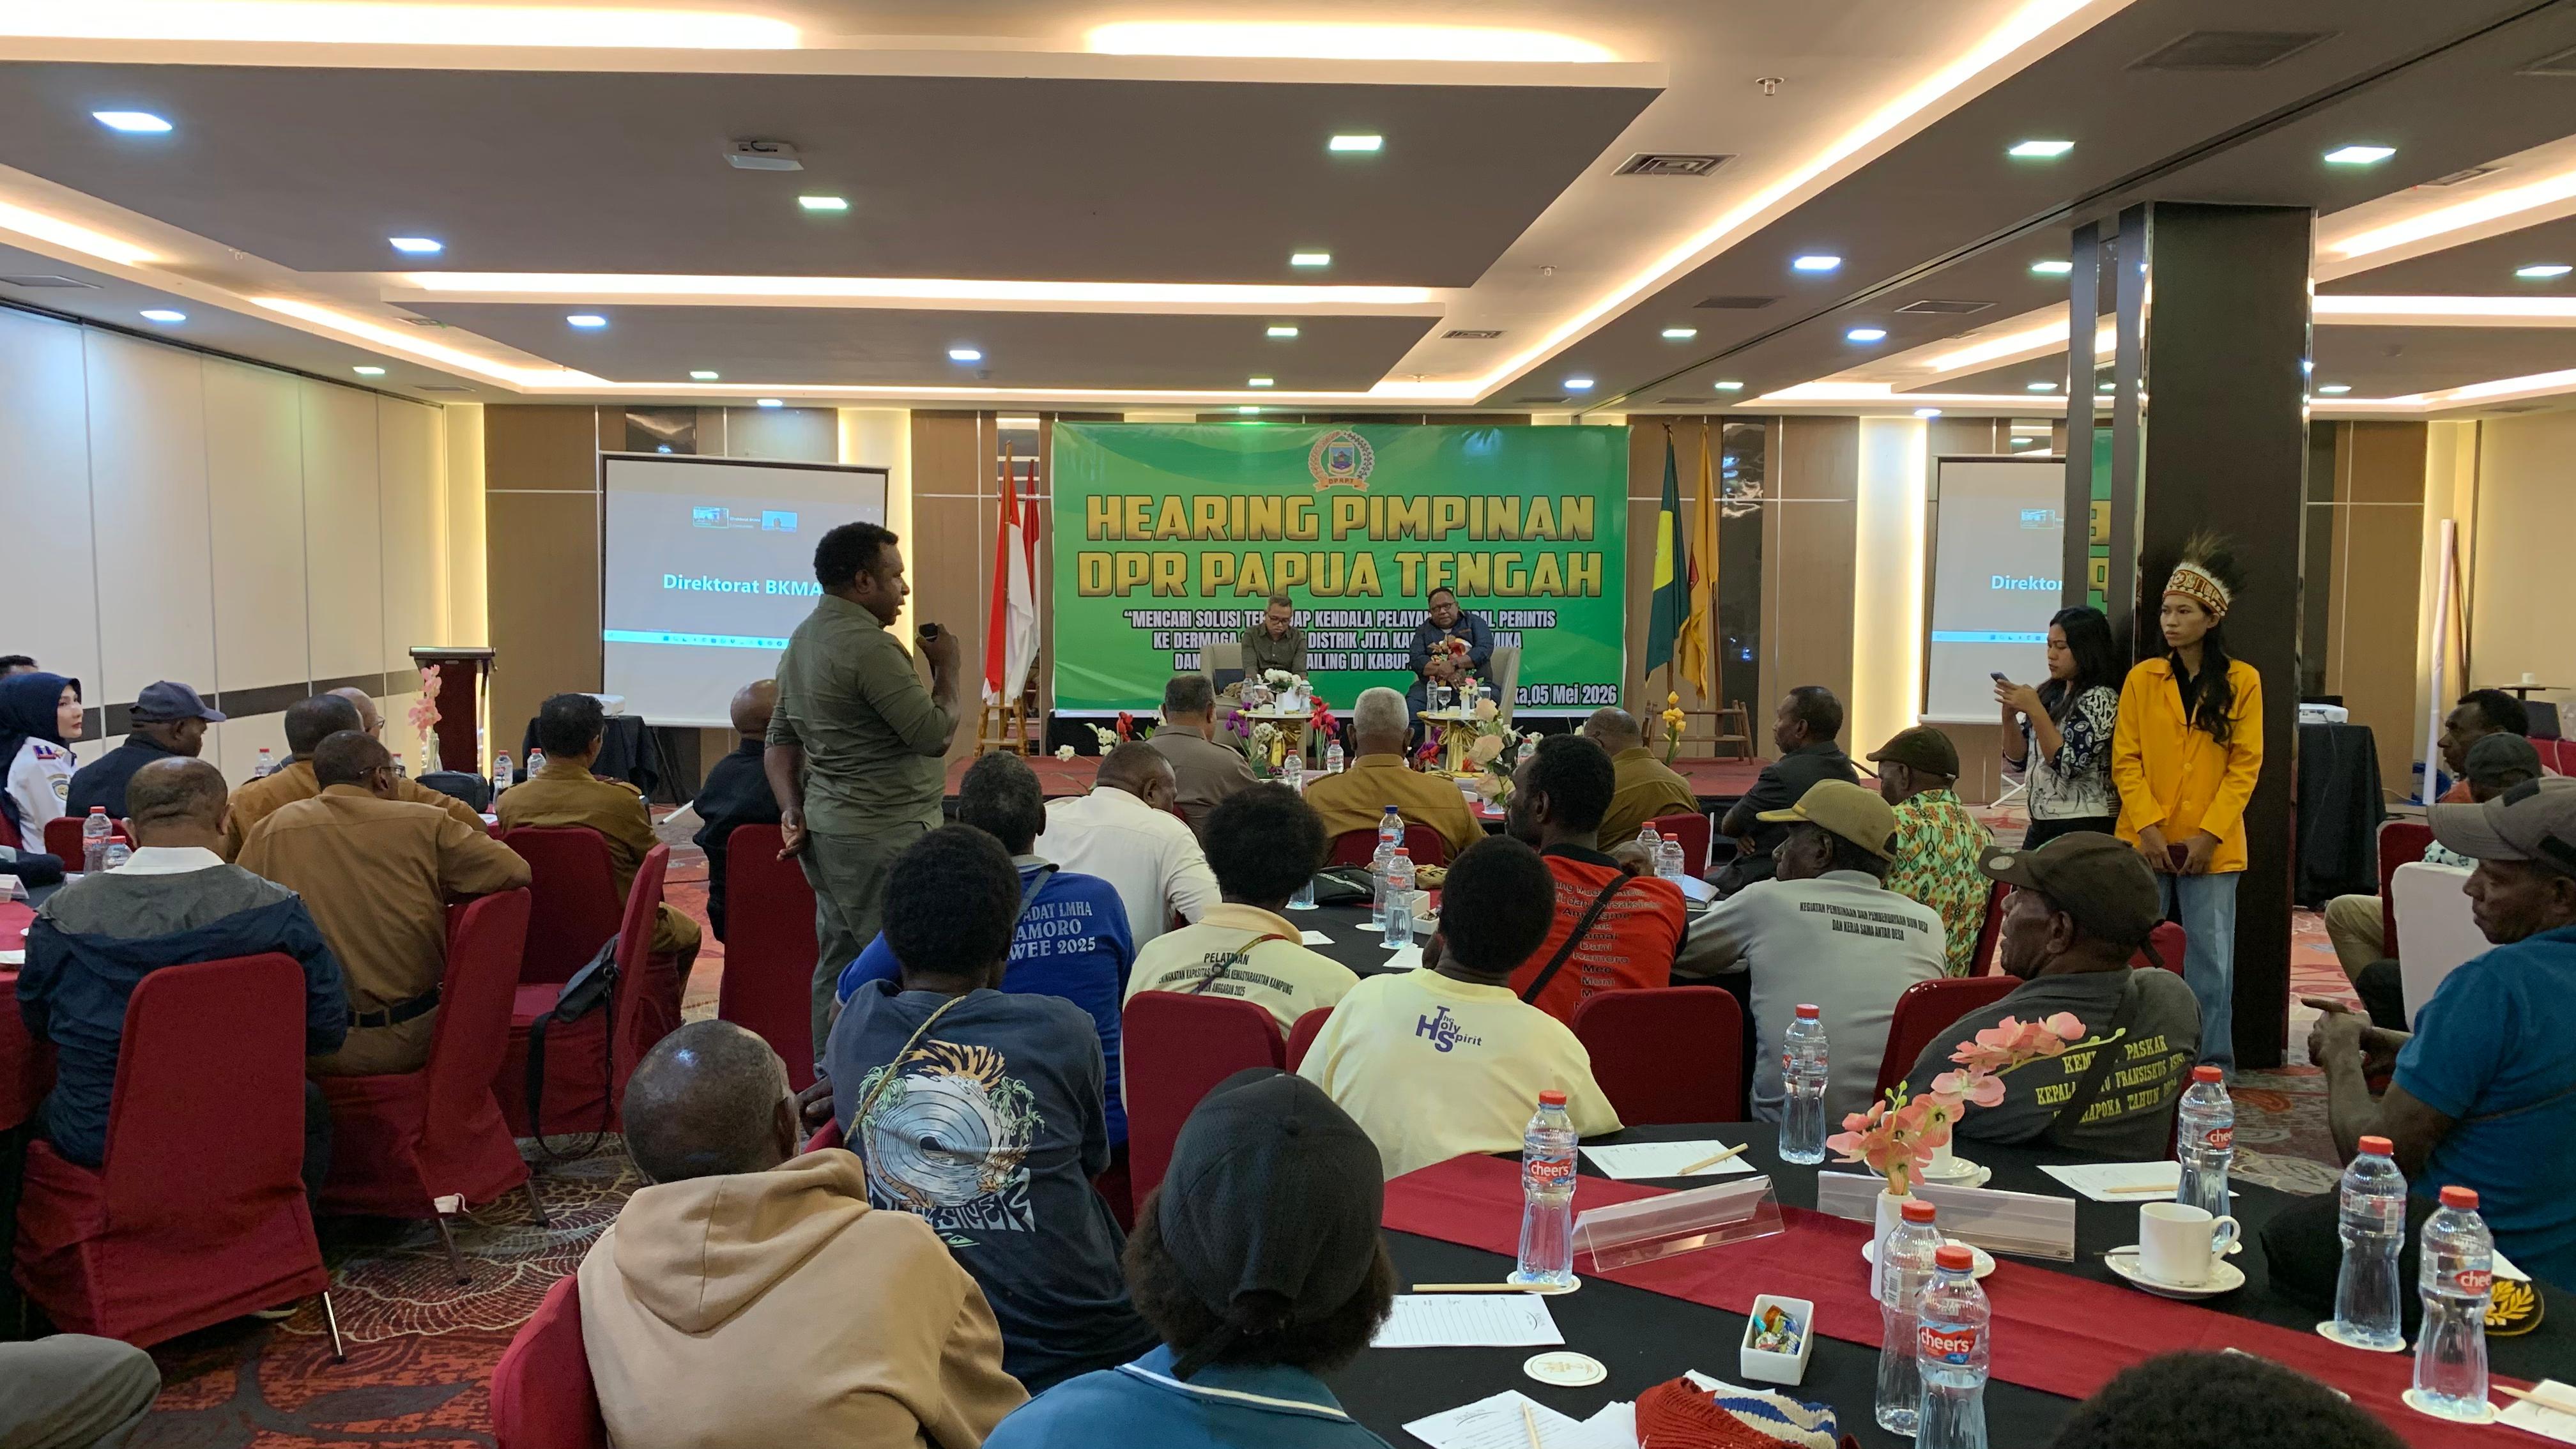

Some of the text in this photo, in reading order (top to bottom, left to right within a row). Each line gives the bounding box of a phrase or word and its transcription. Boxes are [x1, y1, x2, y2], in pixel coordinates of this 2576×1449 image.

[1086, 495, 1595, 541] HEARING PIMPINAN
[664, 574, 760, 594] Direktorat
[1078, 551, 1603, 597] DPR PAPUA TENGAH
[1195, 611, 1241, 627] SOLUSI
[1315, 611, 1372, 627] KENDALA
[1499, 611, 1556, 627] PERINTIS
[1153, 632, 1170, 648] KE
[1174, 632, 1237, 648] DERMAGA
[1308, 632, 1357, 648] DISTRIK
[1361, 632, 1389, 648] JITA
[1351, 653, 1365, 670] DI
[1553, 684, 1579, 704] Mei
[1583, 684, 1617, 704] 2026
[1058, 901, 1093, 917] LMHA
[1800, 901, 1825, 914] KEGIATAN
[1011, 918, 1082, 942] AMORO
[1832, 919, 1843, 931] DAN
[1843, 921, 1860, 934] KERJA
[1874, 926, 1891, 939] ANTAR
[1891, 928, 1905, 941] DESA
[1057, 936, 1096, 954] 2025
[1269, 977, 1294, 995] KAMPUNG
[1415, 1014, 1462, 1041] Holy
[1434, 1030, 1482, 1053] Spirit
[2115, 1059, 2167, 1089] FRANSISKUS
[2127, 1087, 2160, 1111] TAHUN
[1920, 1328, 1970, 1353] cheers
